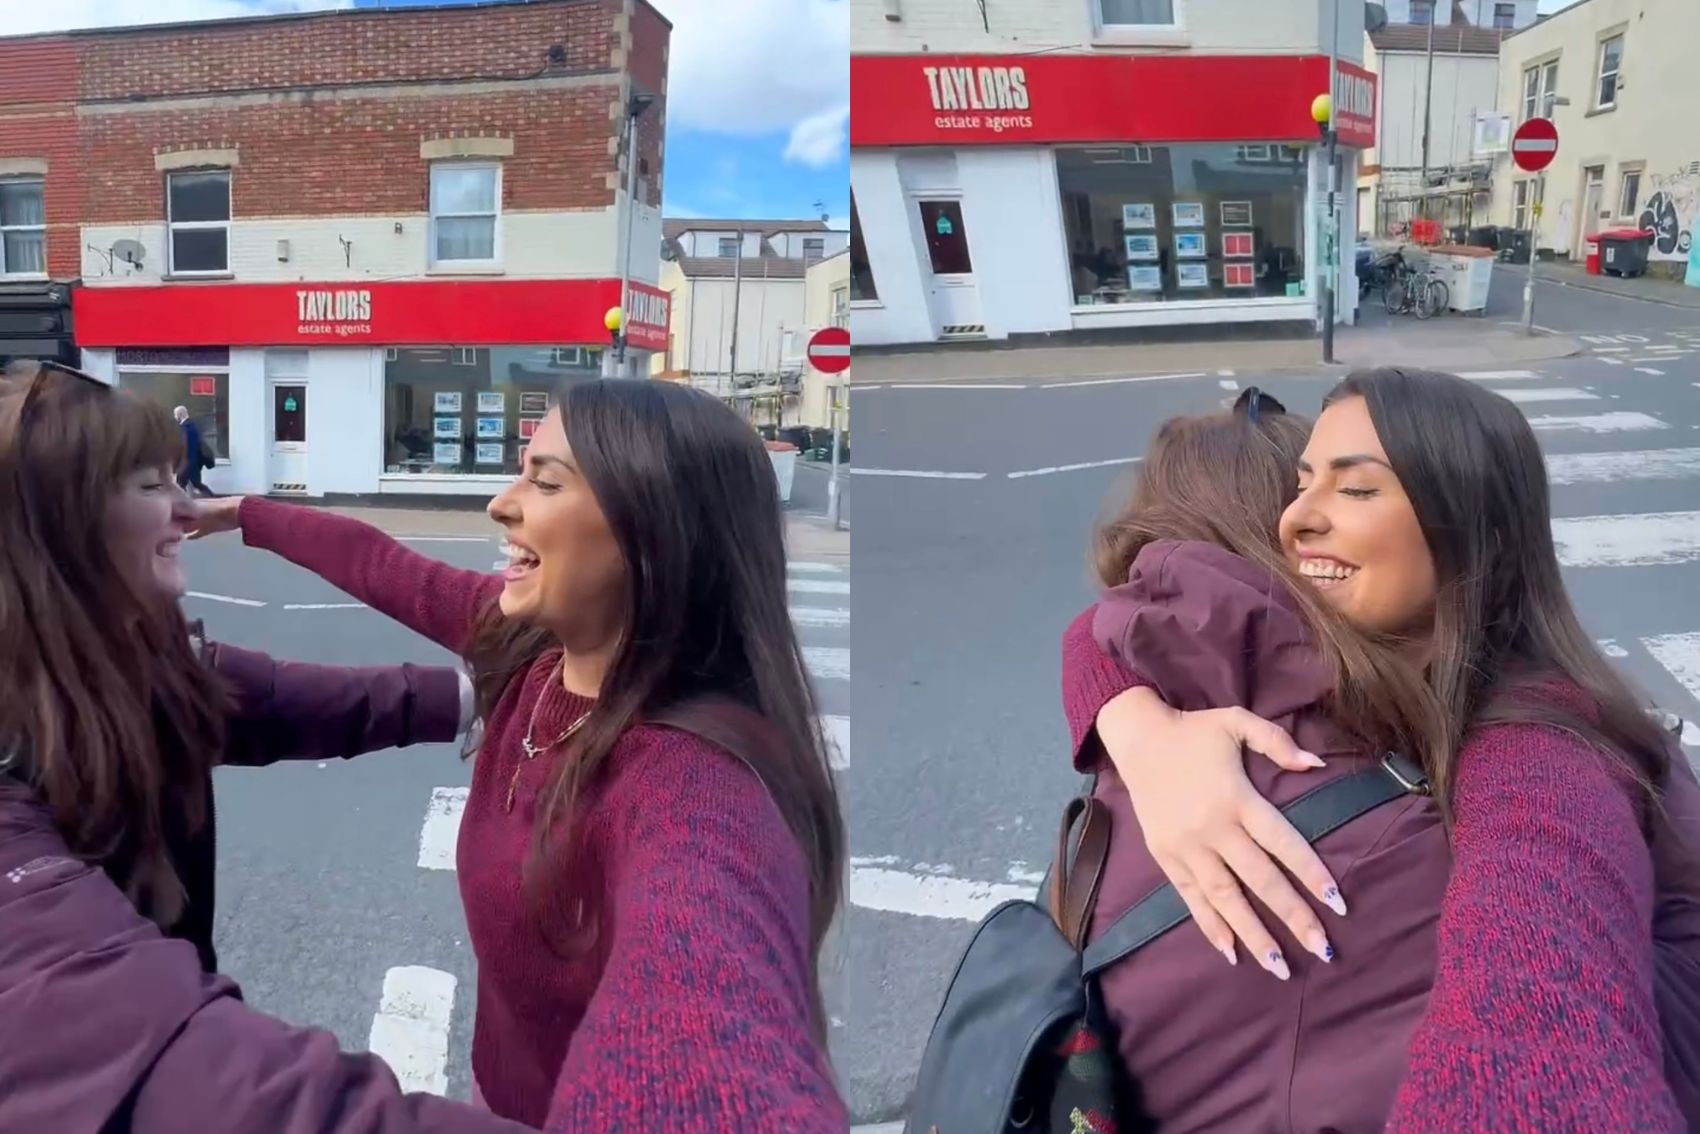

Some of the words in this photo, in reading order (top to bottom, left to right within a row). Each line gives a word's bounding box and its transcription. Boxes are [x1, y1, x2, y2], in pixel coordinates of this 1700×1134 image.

[923, 66, 1030, 110] TAYLORS
[935, 116, 980, 128] estate
[985, 116, 1032, 132] agents
[296, 289, 371, 321] TAYLORS
[298, 325, 331, 333] estate
[336, 325, 371, 336] agents
